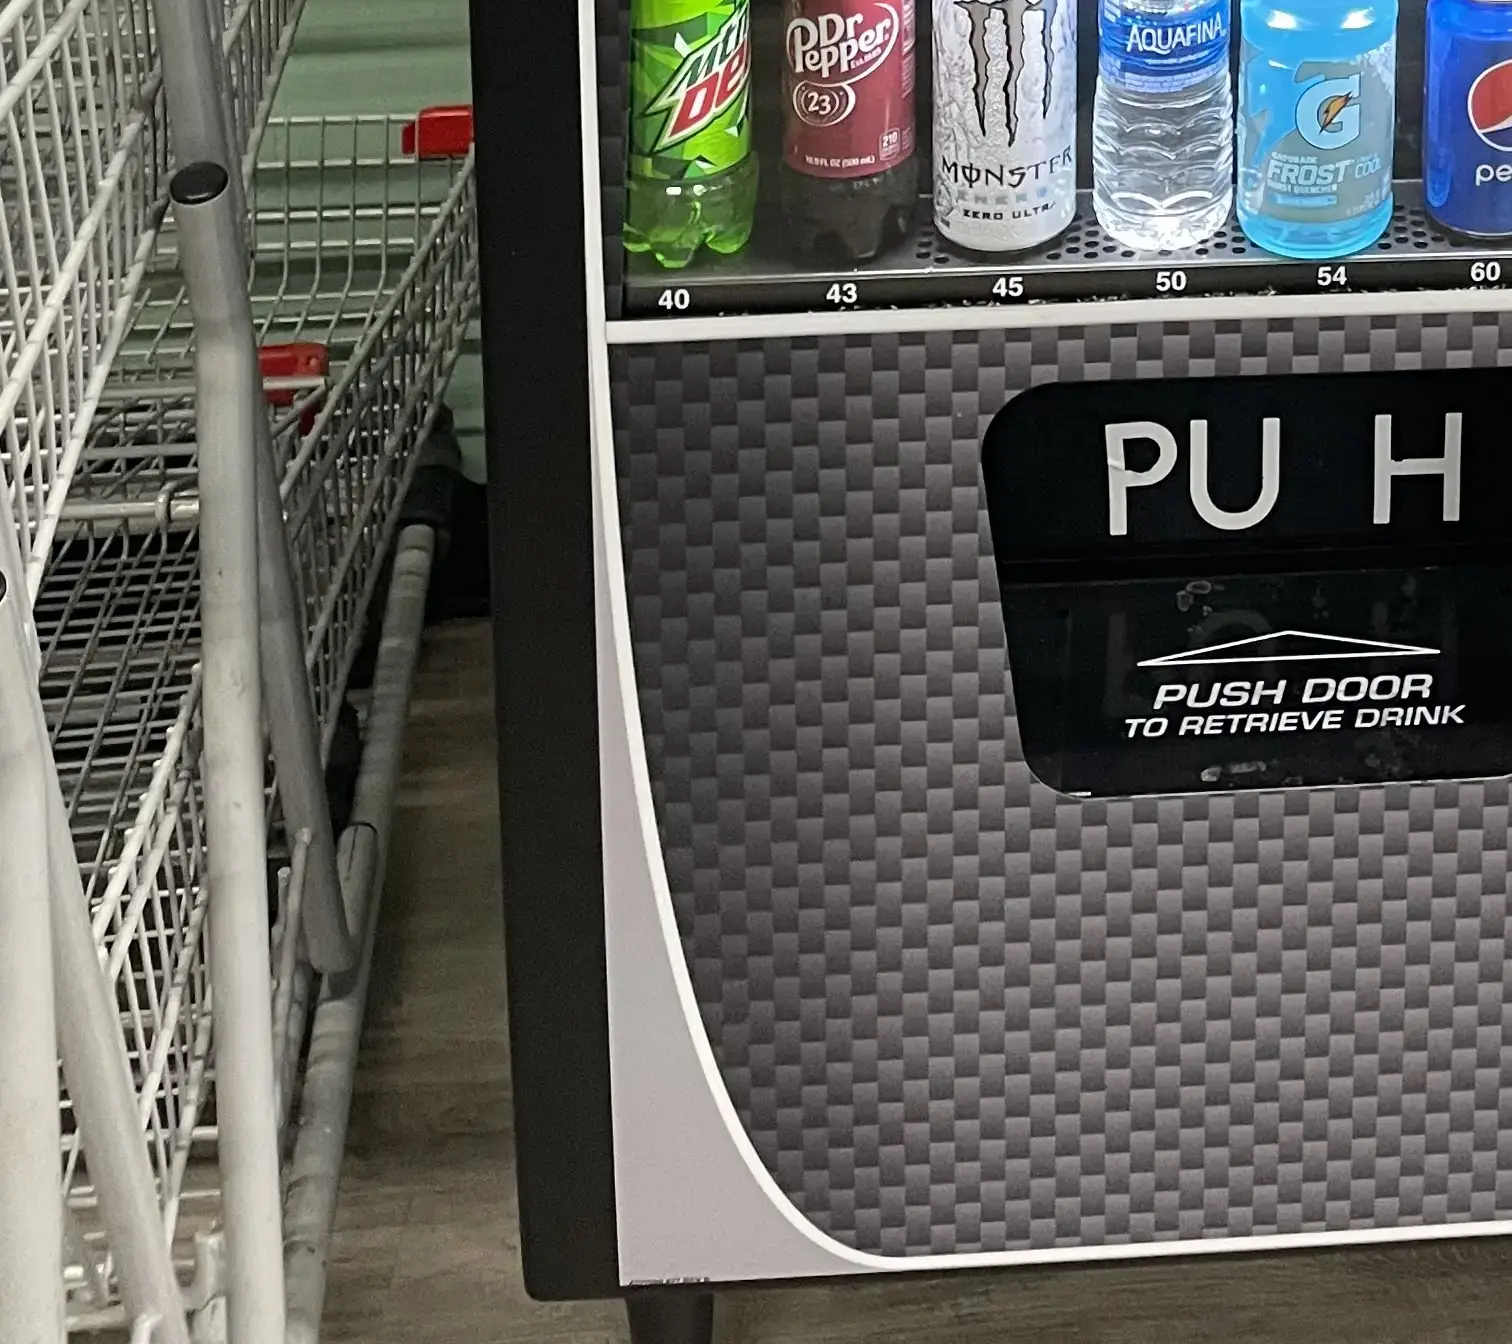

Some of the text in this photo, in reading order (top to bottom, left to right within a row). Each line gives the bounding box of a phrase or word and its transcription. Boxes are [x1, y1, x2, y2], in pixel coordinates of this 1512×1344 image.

[818, 13, 864, 49] Dr
[1126, 11, 1222, 56] AQUAFINA
[786, 16, 892, 79] Pepper
[807, 92, 832, 115] 23
[1295, 73, 1362, 150] G
[882, 131, 899, 148] 210
[942, 144, 1073, 189] MONSTER
[1267, 158, 1354, 186] FROST
[962, 208, 1004, 221] ZERO
[1155, 270, 1188, 292] 50
[1316, 265, 1348, 288] 54
[1469, 261, 1502, 283] 60
[826, 282, 859, 304] 43
[991, 277, 1025, 298] 45
[658, 289, 691, 311] 40
[1153, 672, 1434, 710] PUSH DOOR
[1124, 704, 1466, 739] TO RETRIEVE DRINK
